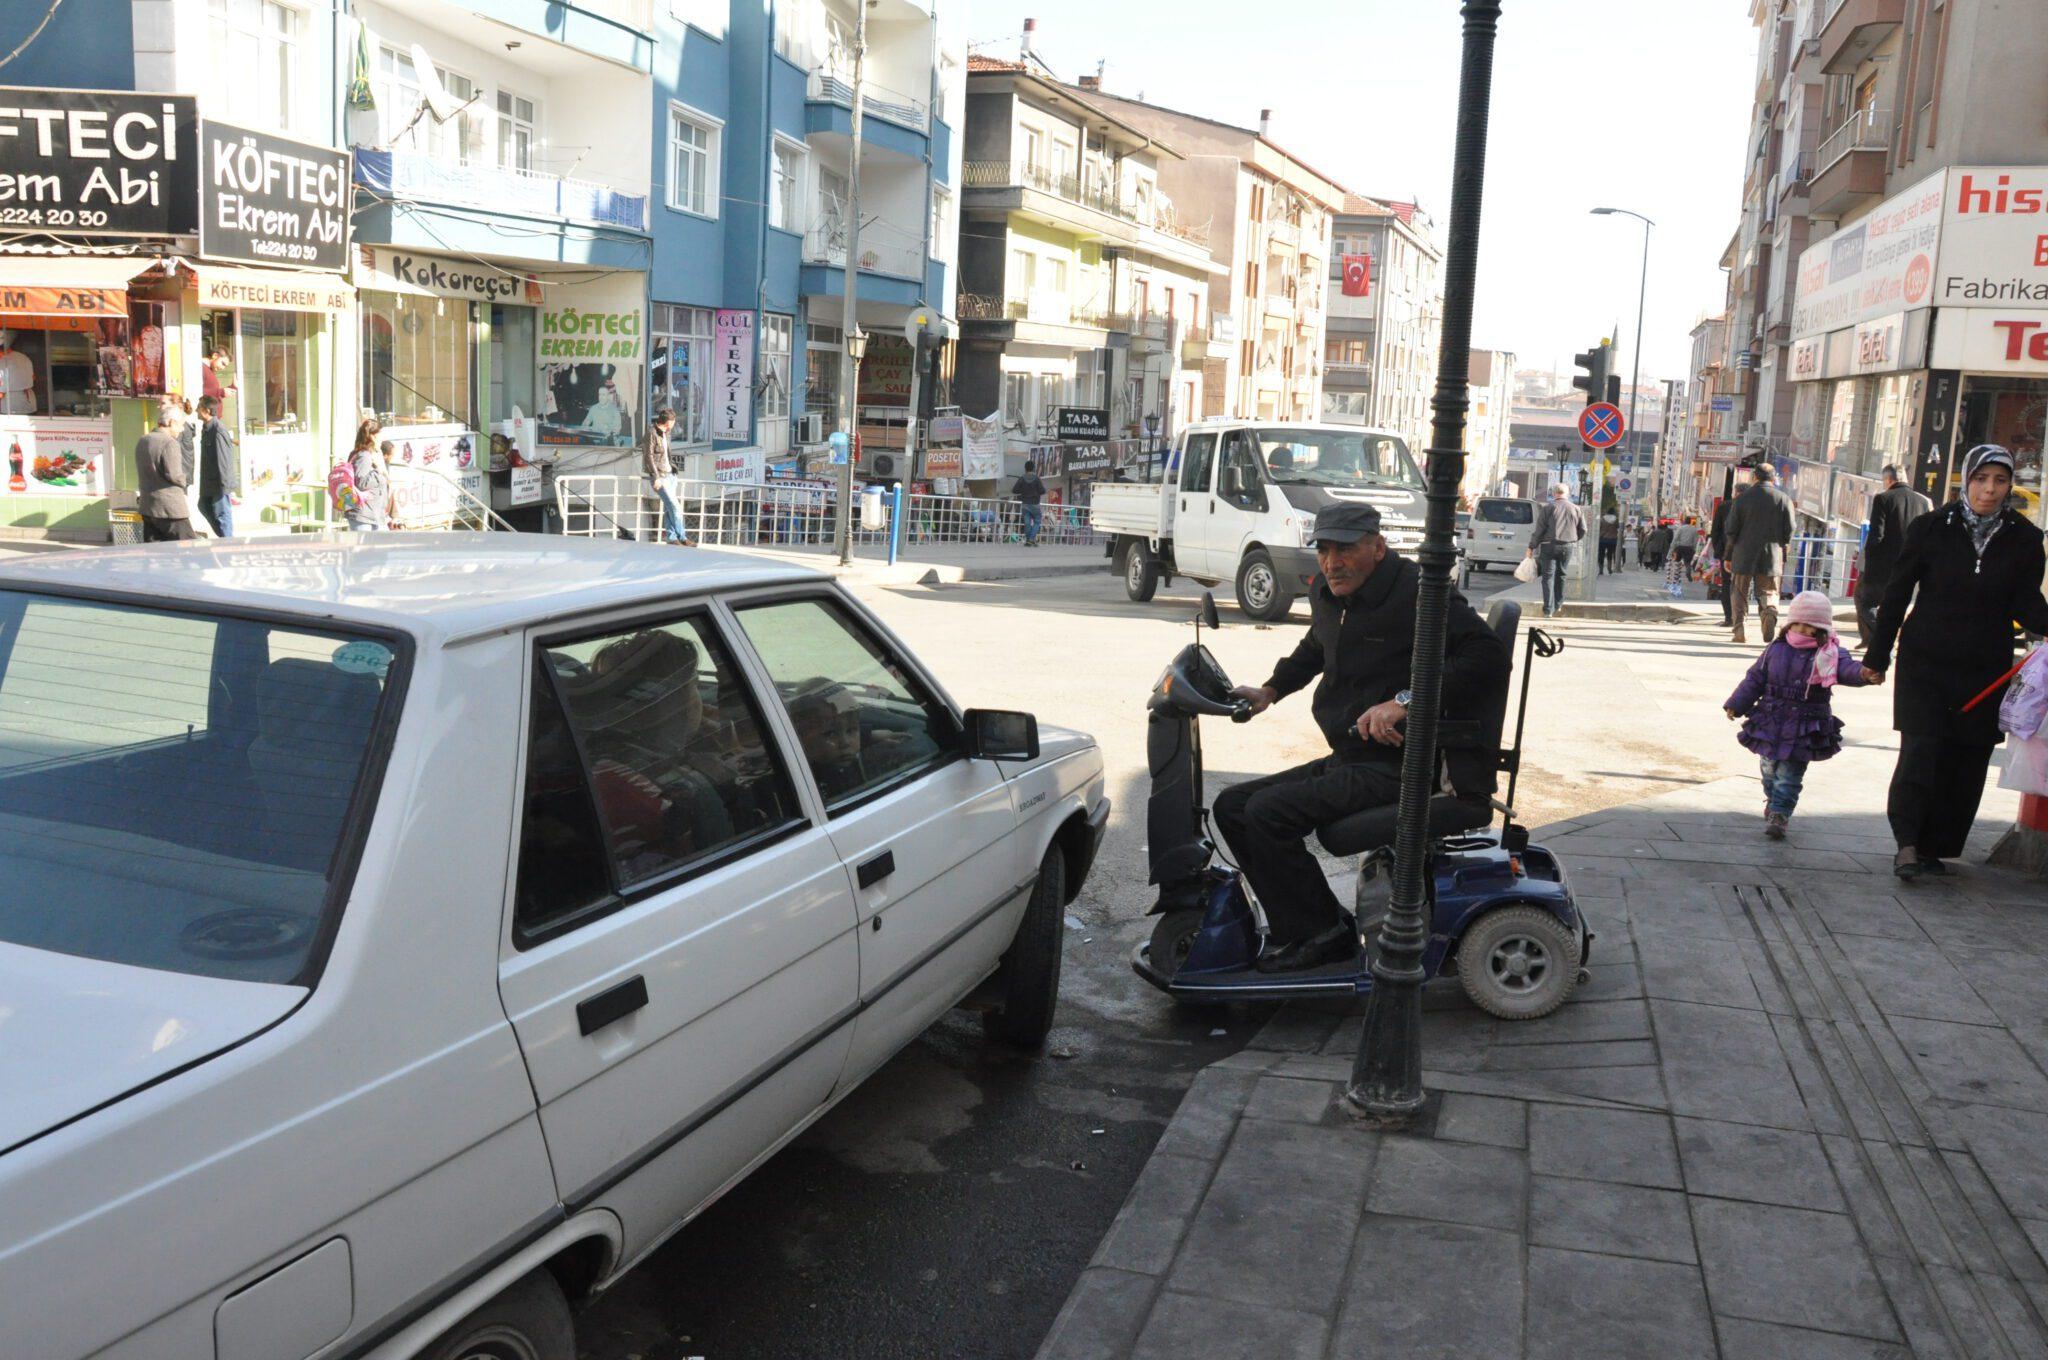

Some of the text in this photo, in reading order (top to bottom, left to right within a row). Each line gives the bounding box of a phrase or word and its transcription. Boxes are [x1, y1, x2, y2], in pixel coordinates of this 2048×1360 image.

[79, 166, 160, 207] Abi
[213, 136, 345, 209] KÖFTECİ
[1957, 175, 2048, 214] his
[46, 209, 75, 226] 20
[217, 192, 343, 245] Ekrem Abi
[0, 289, 106, 310] M ABİ
[211, 281, 347, 309] KÖFTECİ EKREM ABİ
[543, 307, 641, 336] KÖFTECİ
[541, 336, 641, 358] EKREM ABİ
[1066, 413, 1099, 425] TARA
[1075, 445, 1106, 459] TARA
